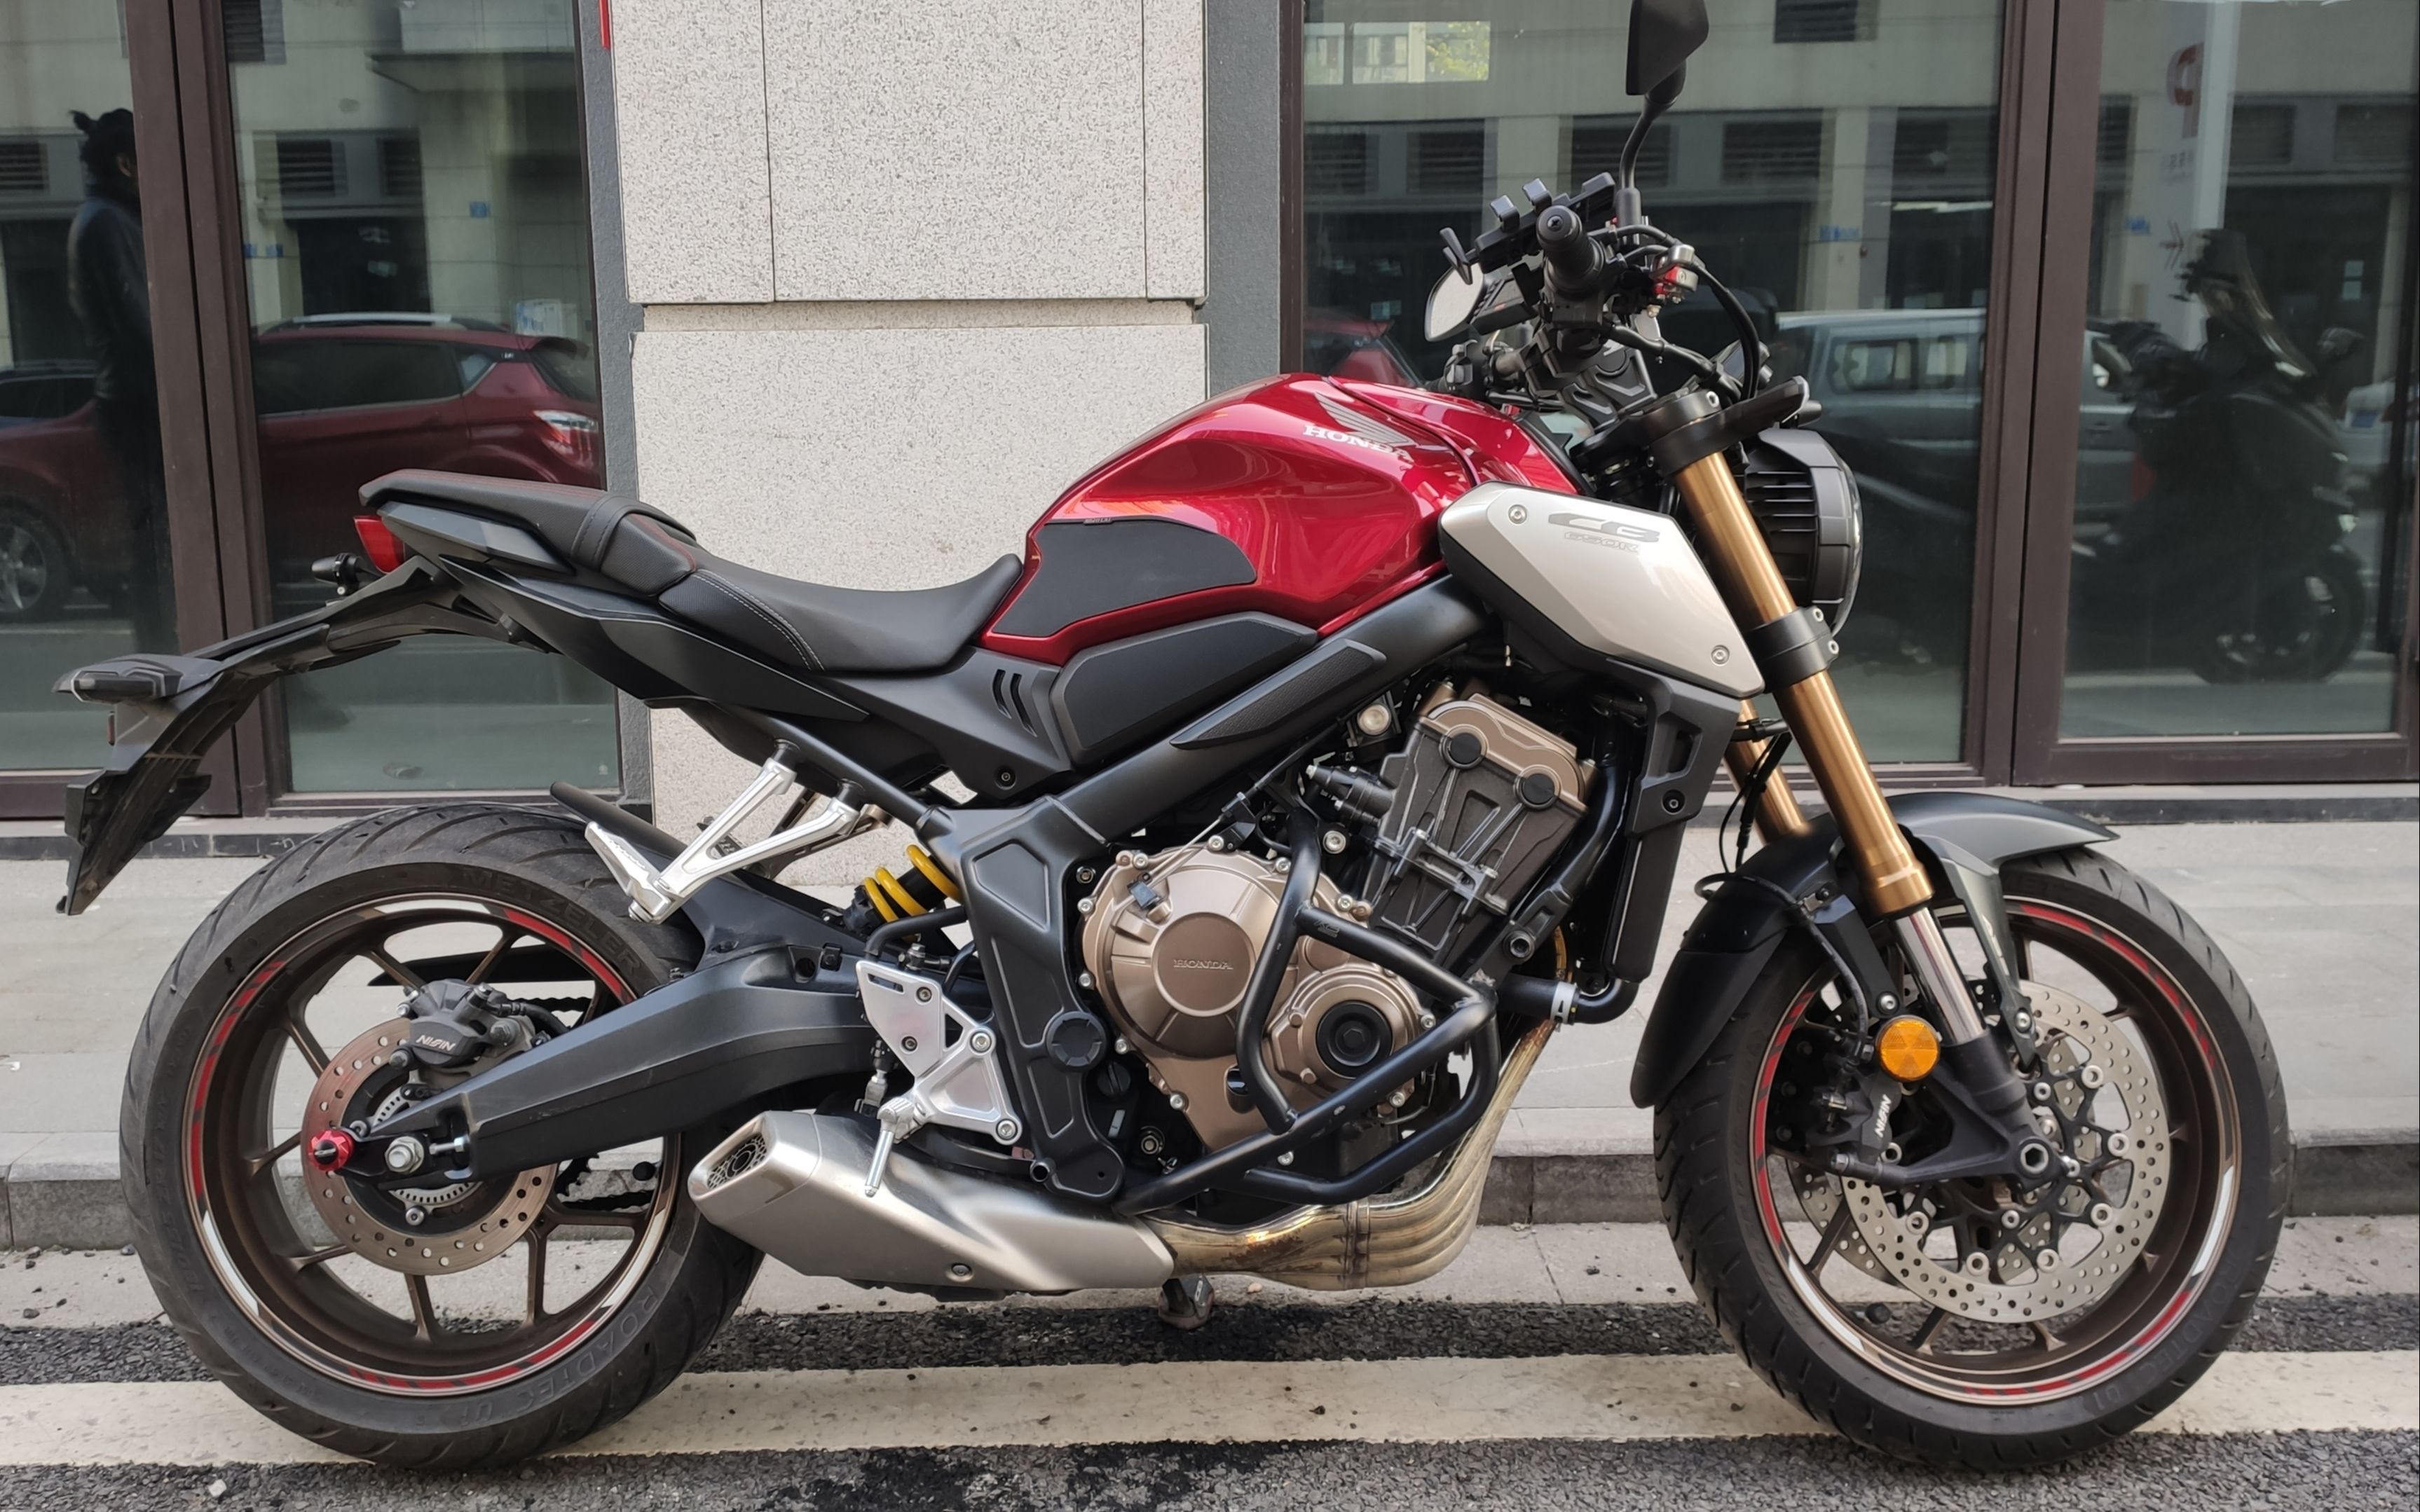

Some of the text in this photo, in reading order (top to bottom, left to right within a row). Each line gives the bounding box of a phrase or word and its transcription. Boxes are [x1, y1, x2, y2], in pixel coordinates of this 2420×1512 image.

[1302, 425, 1414, 471] HONDA
[1548, 513, 1660, 543] CB
[1564, 531, 1639, 553] 650R
[460, 867, 643, 976] METZELER
[1173, 958, 1234, 970] HONDA
[2137, 1258, 2244, 1384] ROADTEC
[514, 1286, 664, 1411] ROADTEC
